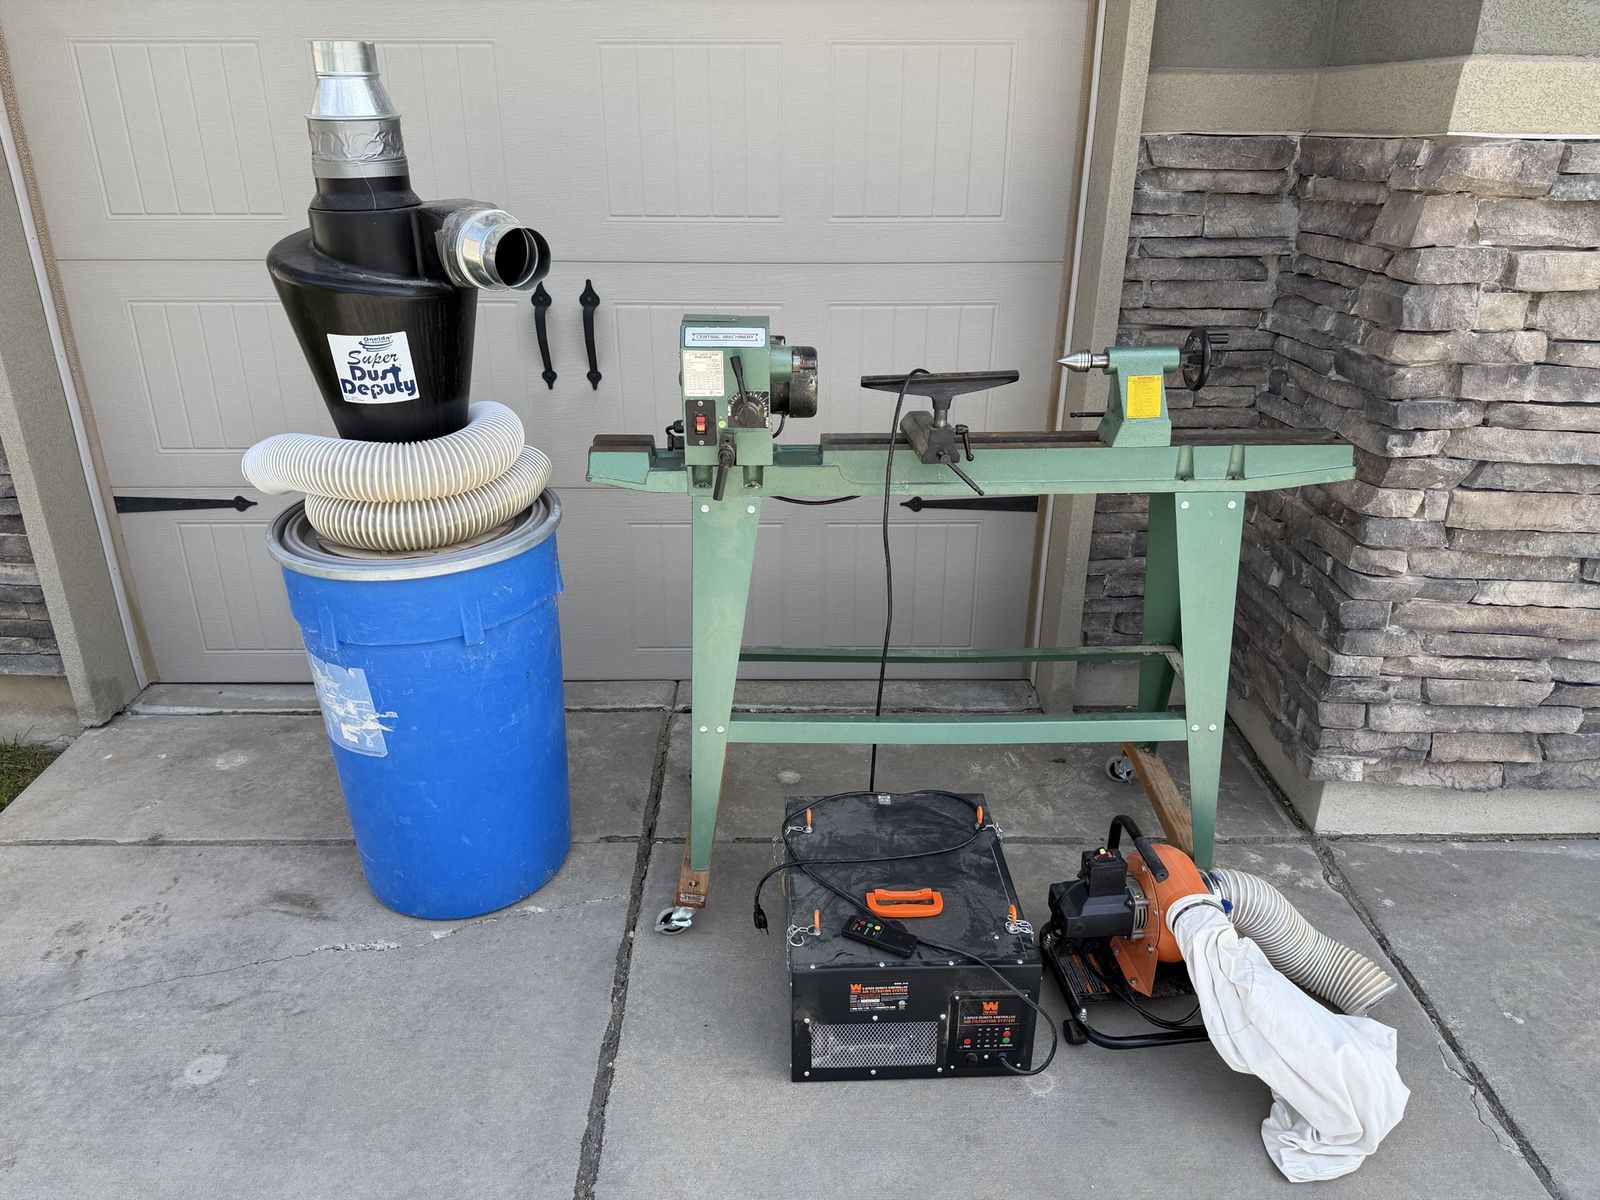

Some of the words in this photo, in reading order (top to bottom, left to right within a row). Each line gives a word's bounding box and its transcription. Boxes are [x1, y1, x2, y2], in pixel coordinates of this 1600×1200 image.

[347, 350, 399, 368] Super
[349, 364, 402, 381] Dust
[340, 378, 417, 399] Deputy
